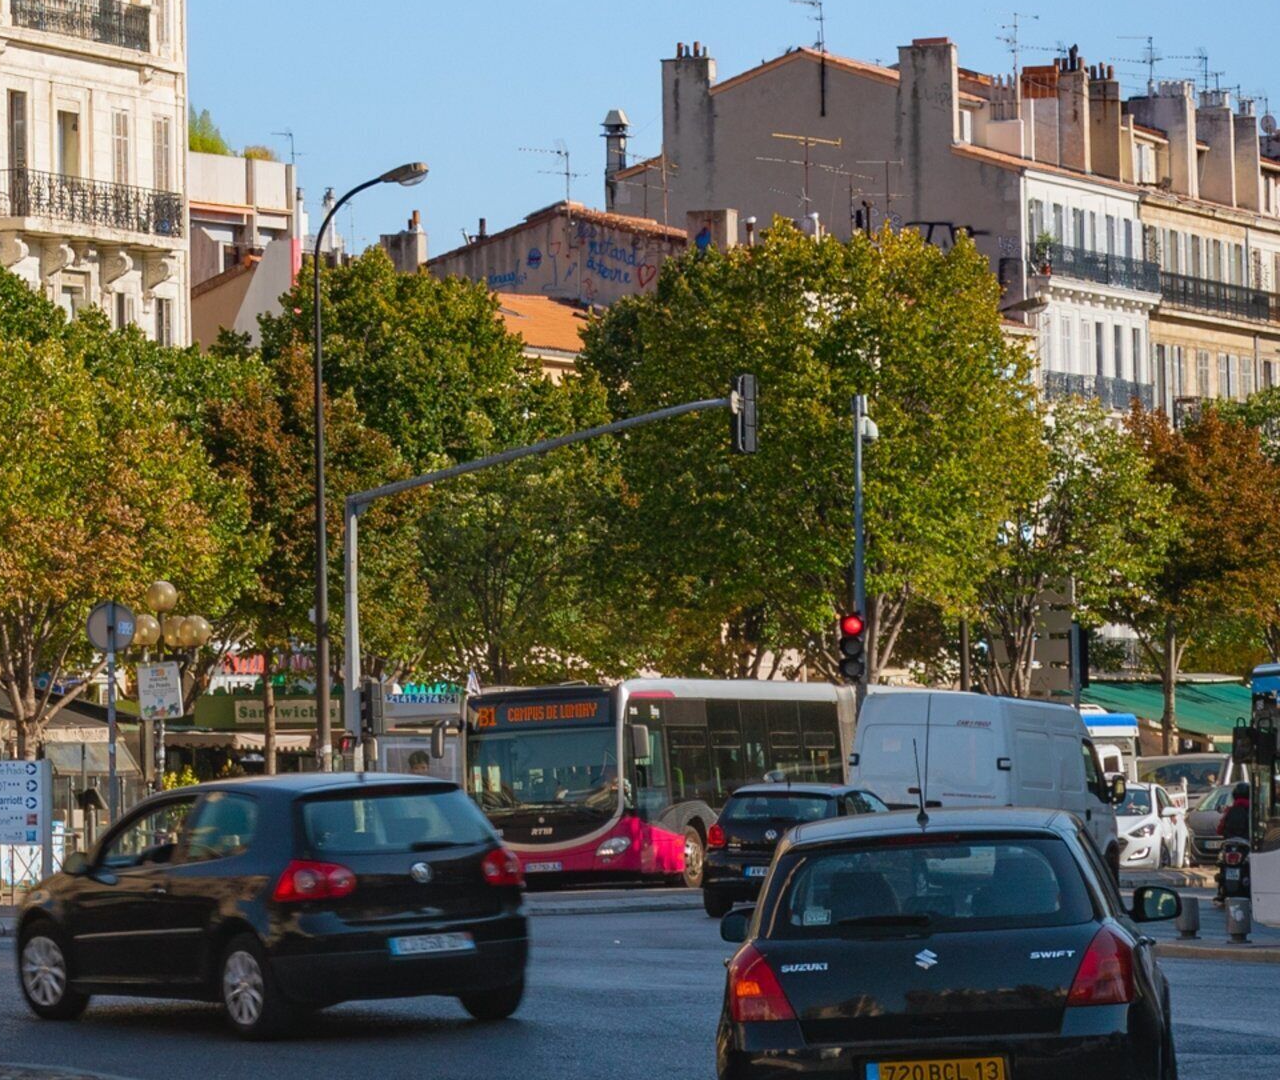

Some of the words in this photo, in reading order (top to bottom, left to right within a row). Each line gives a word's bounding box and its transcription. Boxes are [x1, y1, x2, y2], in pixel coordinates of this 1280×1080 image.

[239, 705, 337, 719] Sanwichs
[477, 706, 497, 727] B1
[507, 704, 545, 723] CAMPUS
[545, 704, 558, 720] DE
[559, 701, 598, 719] LUMINY
[1030, 949, 1076, 959] SWIFT
[781, 962, 829, 973] SUZUKI
[883, 1065, 925, 1080] 720
[928, 1063, 969, 1080] BCL
[975, 1061, 1000, 1080] 13
